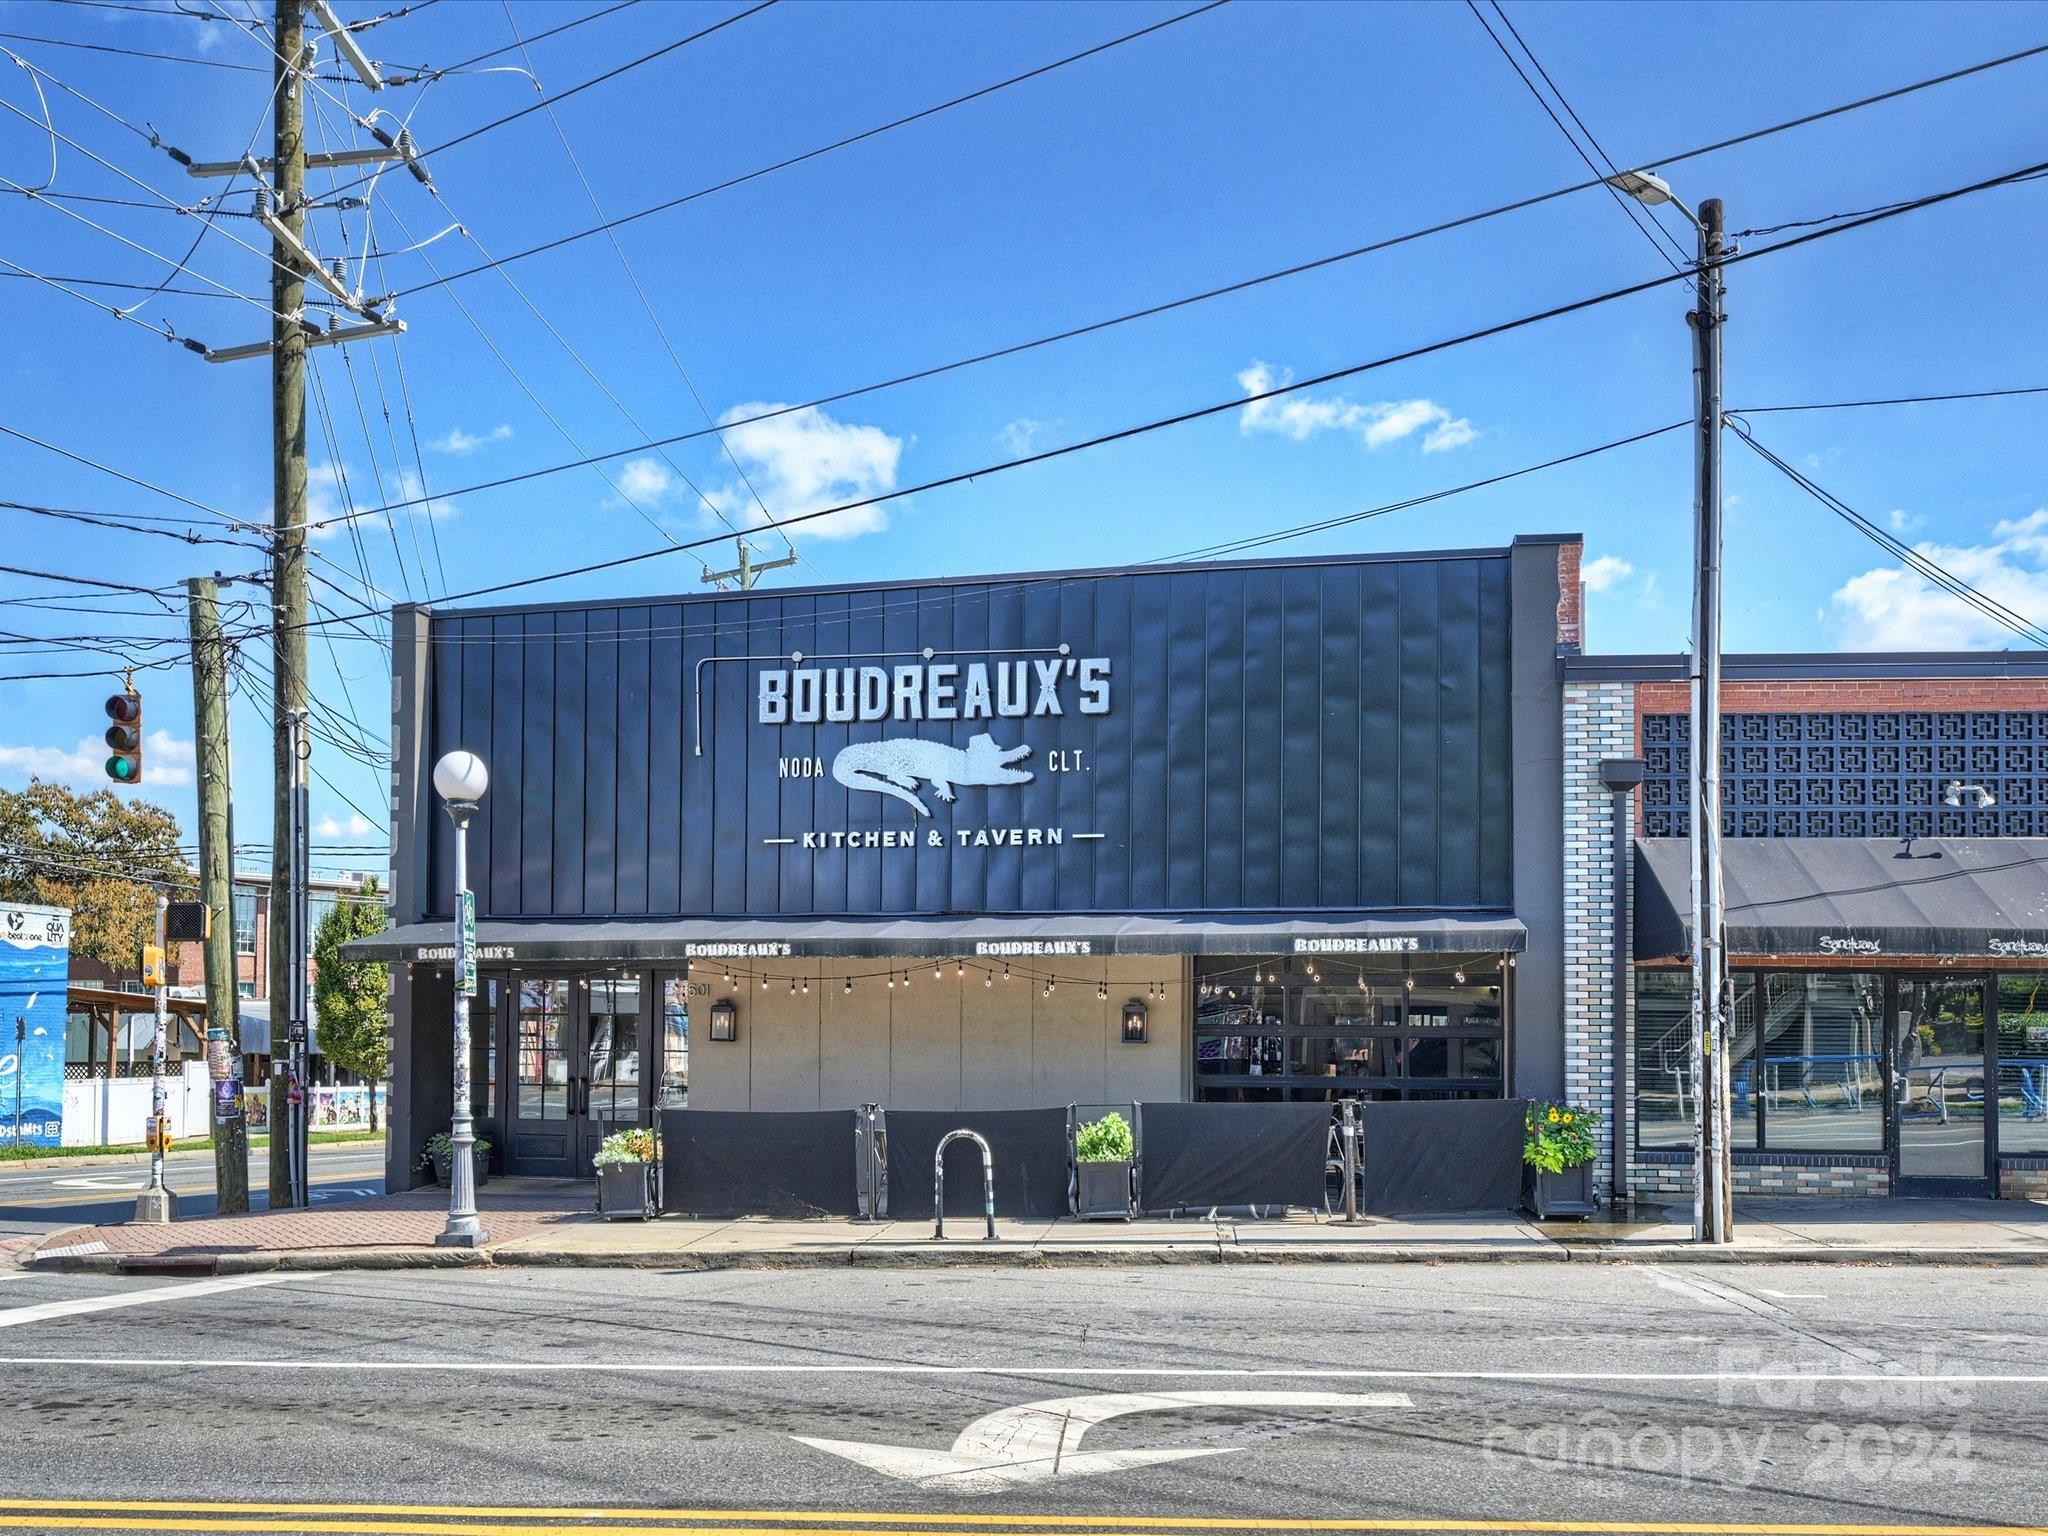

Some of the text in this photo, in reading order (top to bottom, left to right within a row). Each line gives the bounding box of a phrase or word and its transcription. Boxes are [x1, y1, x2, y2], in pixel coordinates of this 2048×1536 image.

[758, 657, 1112, 724] BOUDREAUX'S
[778, 756, 824, 779] NODA
[1048, 750, 1091, 773] CLT.
[803, 827, 1063, 849] KITCHEN & TAVERN
[417, 944, 515, 960] BOUDAUX'S
[685, 942, 792, 957] BOUDREAUX'S
[975, 940, 1091, 955] BOUDREAUX'S
[1294, 937, 1419, 953] BOUDREAUX'S
[1819, 935, 1881, 955] Sanctuary
[688, 983, 710, 997] 501
